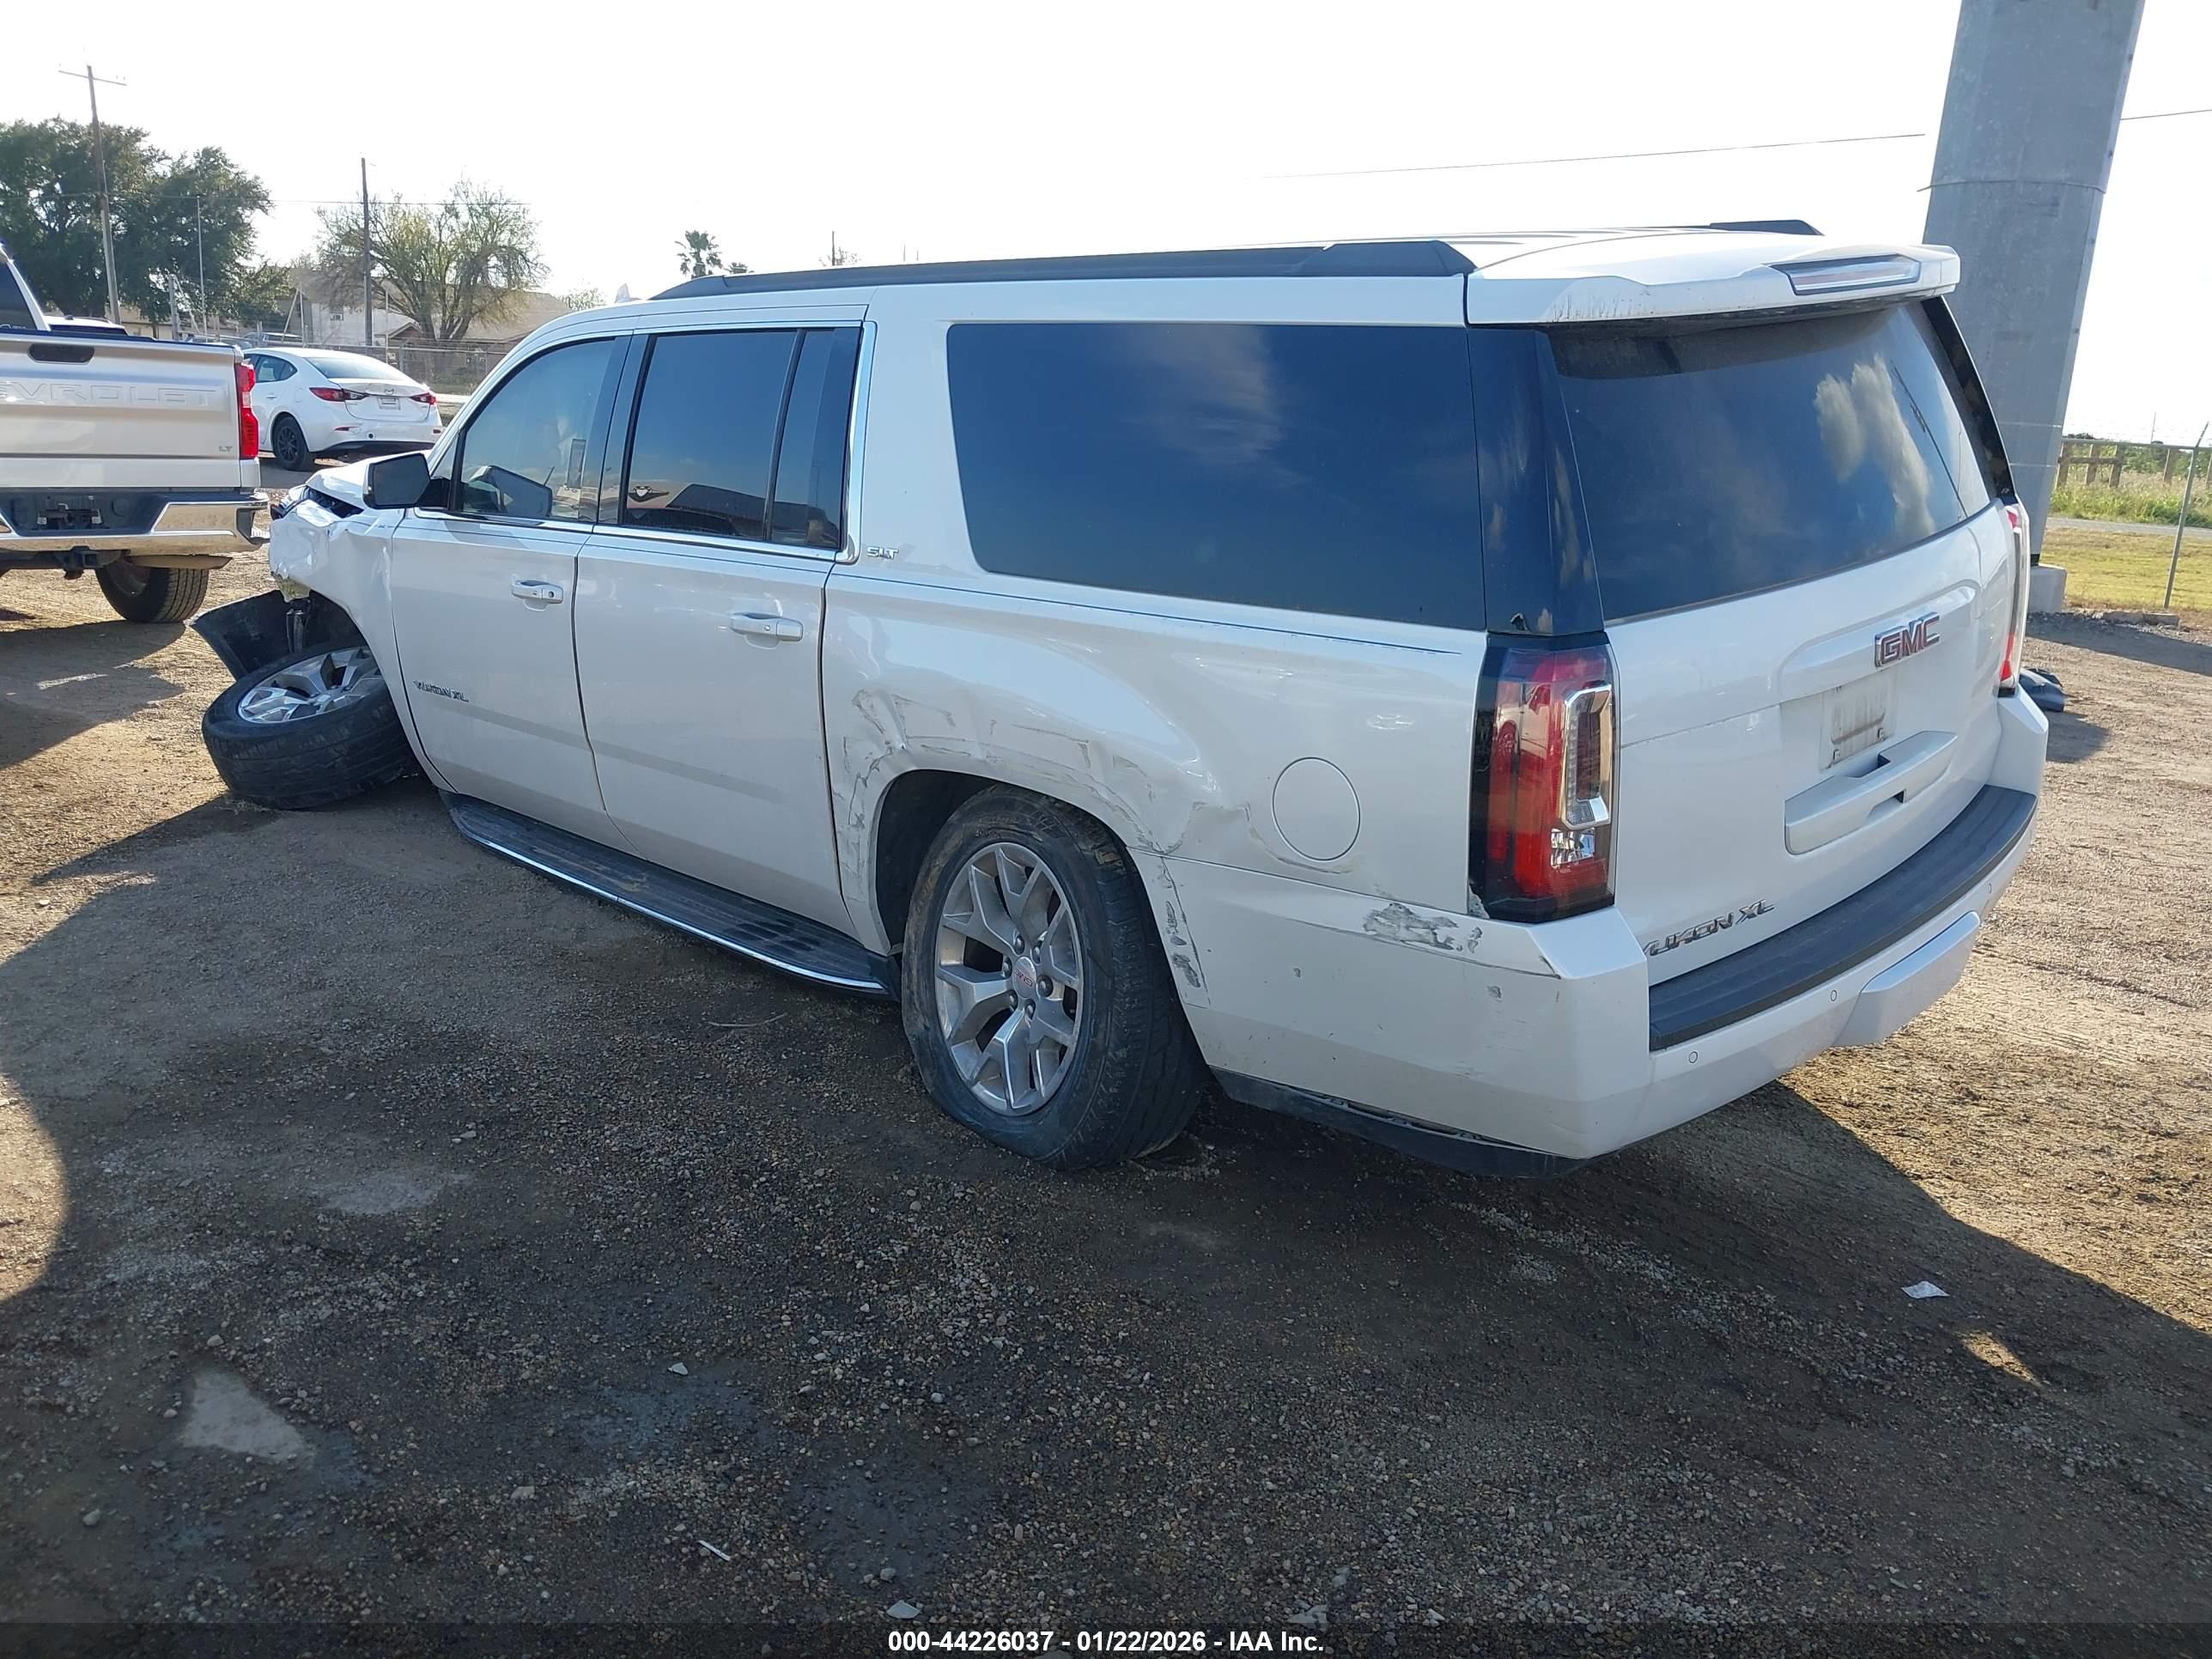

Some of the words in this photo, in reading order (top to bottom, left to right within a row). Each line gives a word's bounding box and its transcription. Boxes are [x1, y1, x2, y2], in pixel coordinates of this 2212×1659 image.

[0, 380, 216, 406] VROLET
[866, 546, 900, 560] SLT
[1874, 611, 1941, 668] GMC
[1735, 898, 1776, 925] XL
[1013, 968, 1034, 988] GMC
